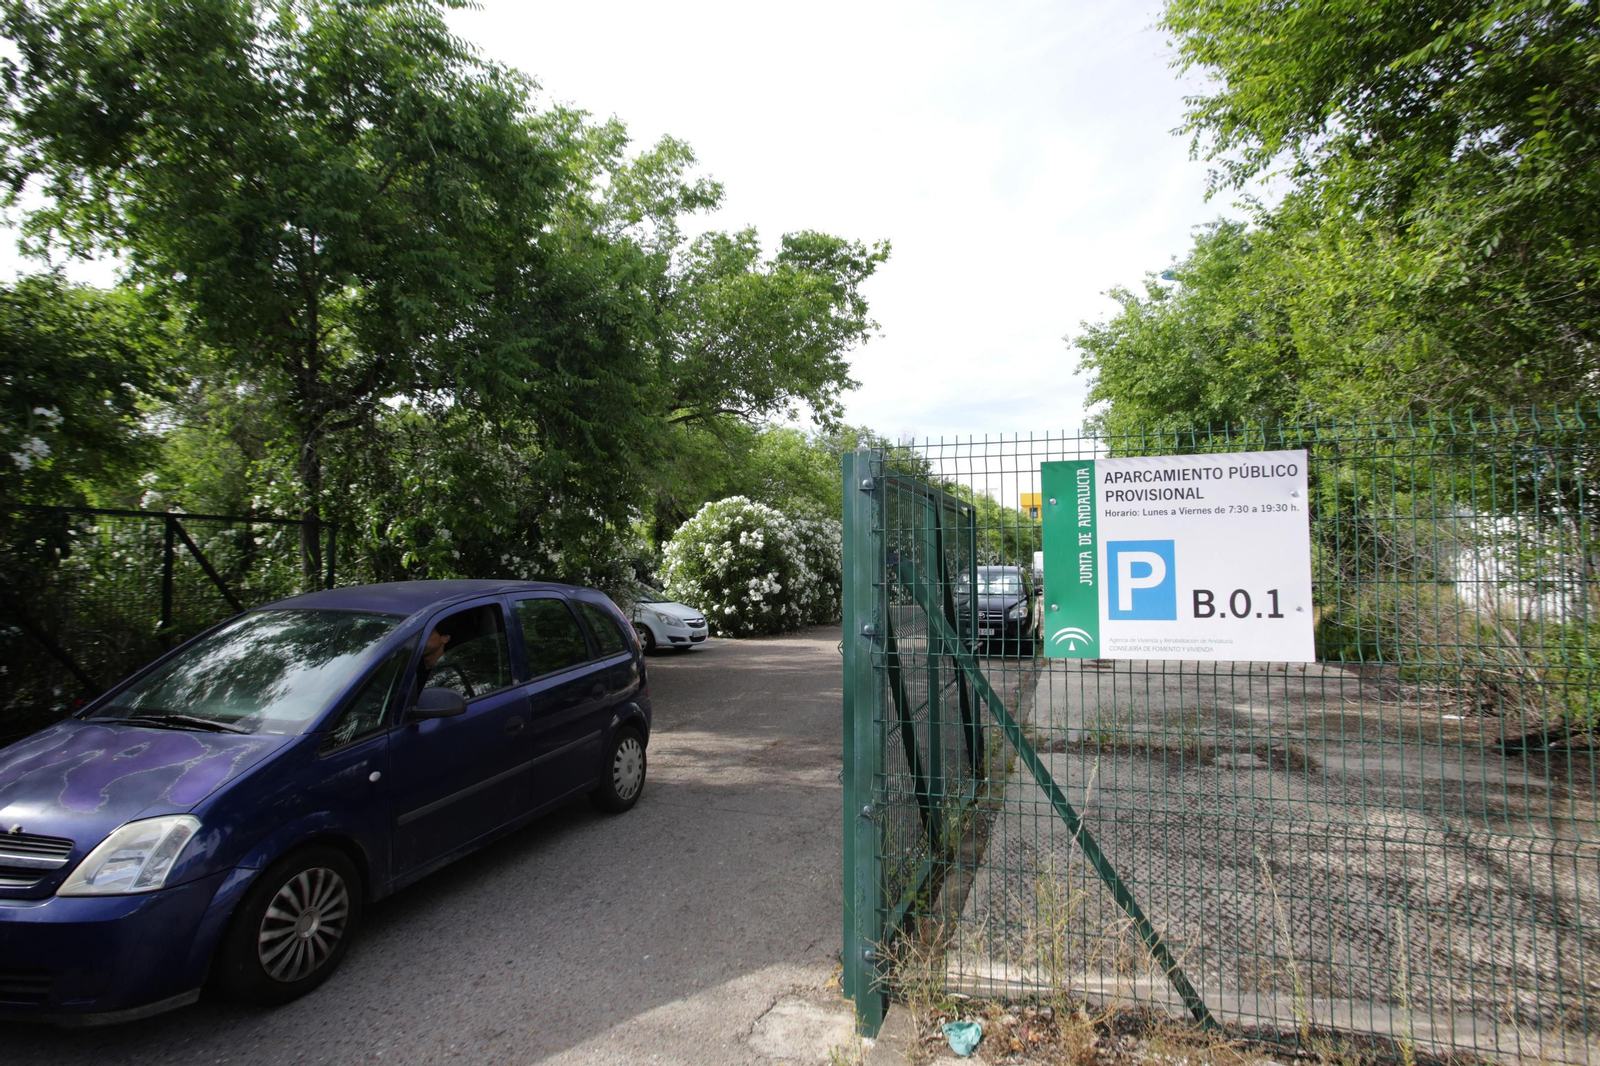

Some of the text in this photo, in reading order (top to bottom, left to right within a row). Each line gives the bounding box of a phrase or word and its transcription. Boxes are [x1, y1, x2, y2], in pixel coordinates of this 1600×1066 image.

[1104, 463, 1298, 484] APARCAMIENTO PÚBLICO
[1105, 487, 1204, 502] PROVISIONAL
[1105, 509, 1140, 517] Horario:
[1142, 508, 1168, 516] Lunes
[1178, 507, 1212, 516] Viernes
[1214, 506, 1226, 514] de
[1228, 506, 1248, 514] 7:30
[1261, 504, 1288, 512] 19:30
[1290, 504, 1300, 512] h.
[1076, 468, 1093, 586] JUNTA DE ANDALUCIA
[1118, 552, 1166, 611] P
